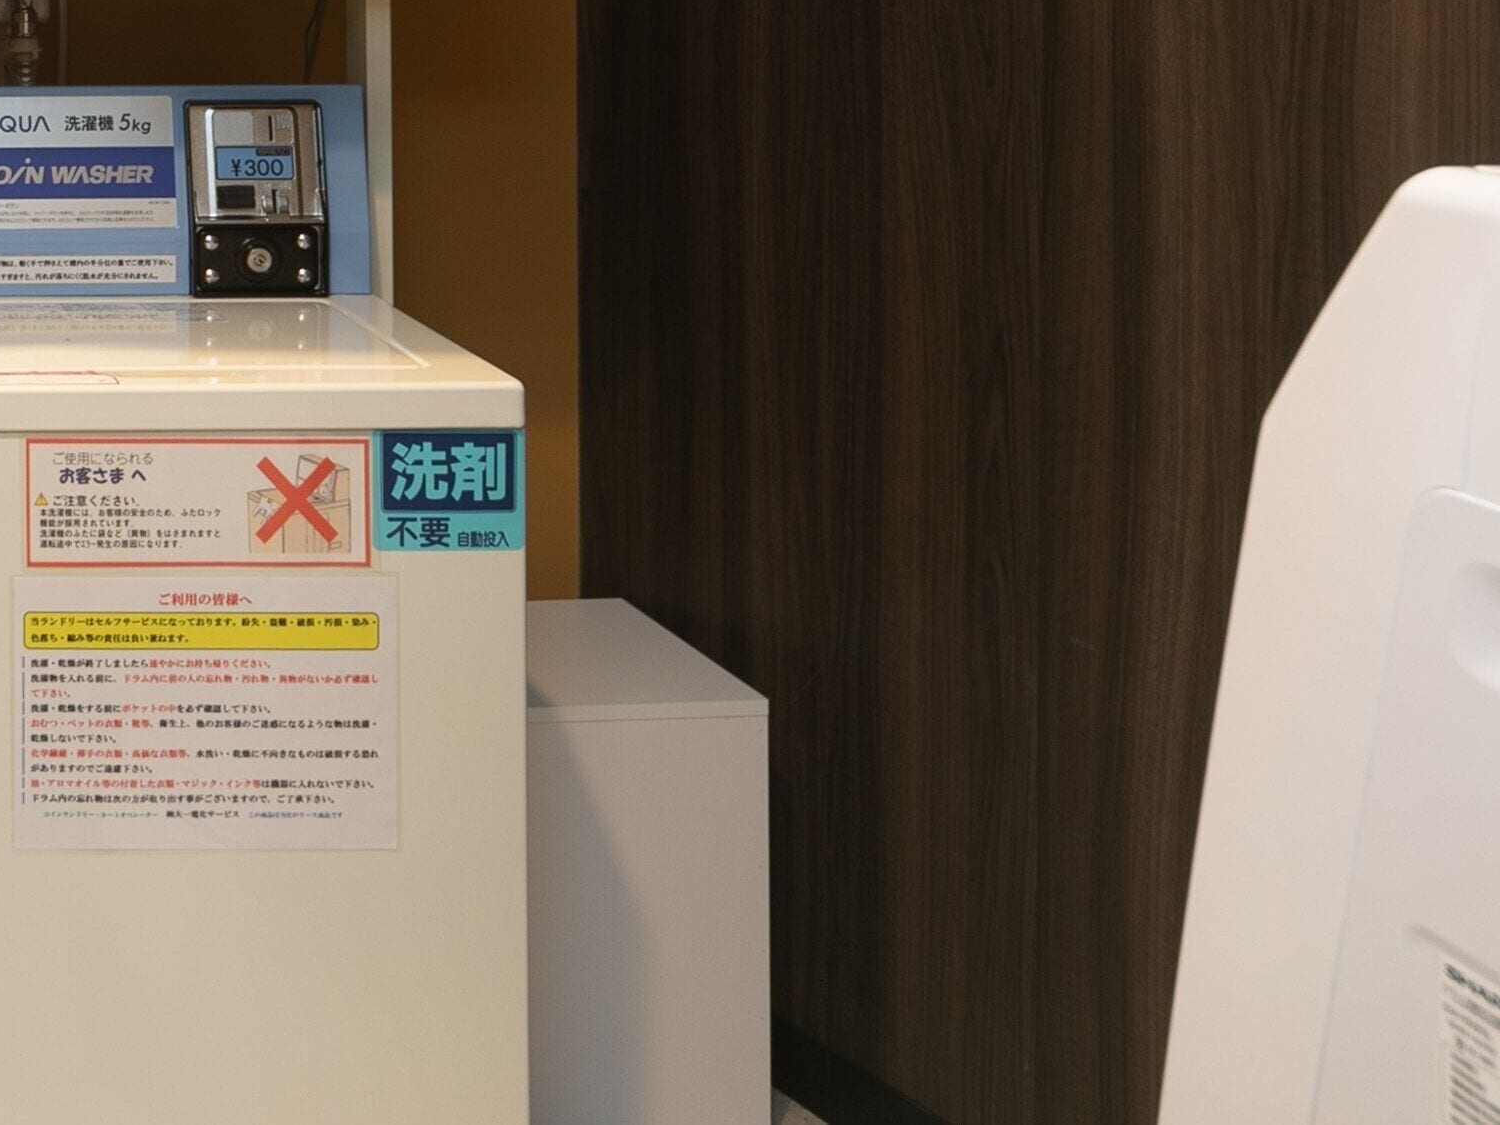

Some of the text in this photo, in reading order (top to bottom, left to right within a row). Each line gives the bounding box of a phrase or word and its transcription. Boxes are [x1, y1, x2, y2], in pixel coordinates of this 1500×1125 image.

[65, 115, 114, 131] 洗濯機
[119, 113, 152, 135] 5kg
[231, 158, 284, 176] ¥300
[52, 165, 155, 185] WASHER
[52, 452, 153, 465] ご使用になられる
[59, 467, 147, 484] お客さま へ
[391, 442, 506, 502] 洗剤
[53, 495, 140, 506] ご注意ください。
[386, 517, 509, 547] 不要 自動投入
[157, 592, 252, 606] ご利用の皆様へ
[31, 689, 71, 698] て下さい。
[31, 734, 117, 744] 乾燥しないで下さい。
[31, 764, 153, 773] がありますのでご遠慮下さい。
